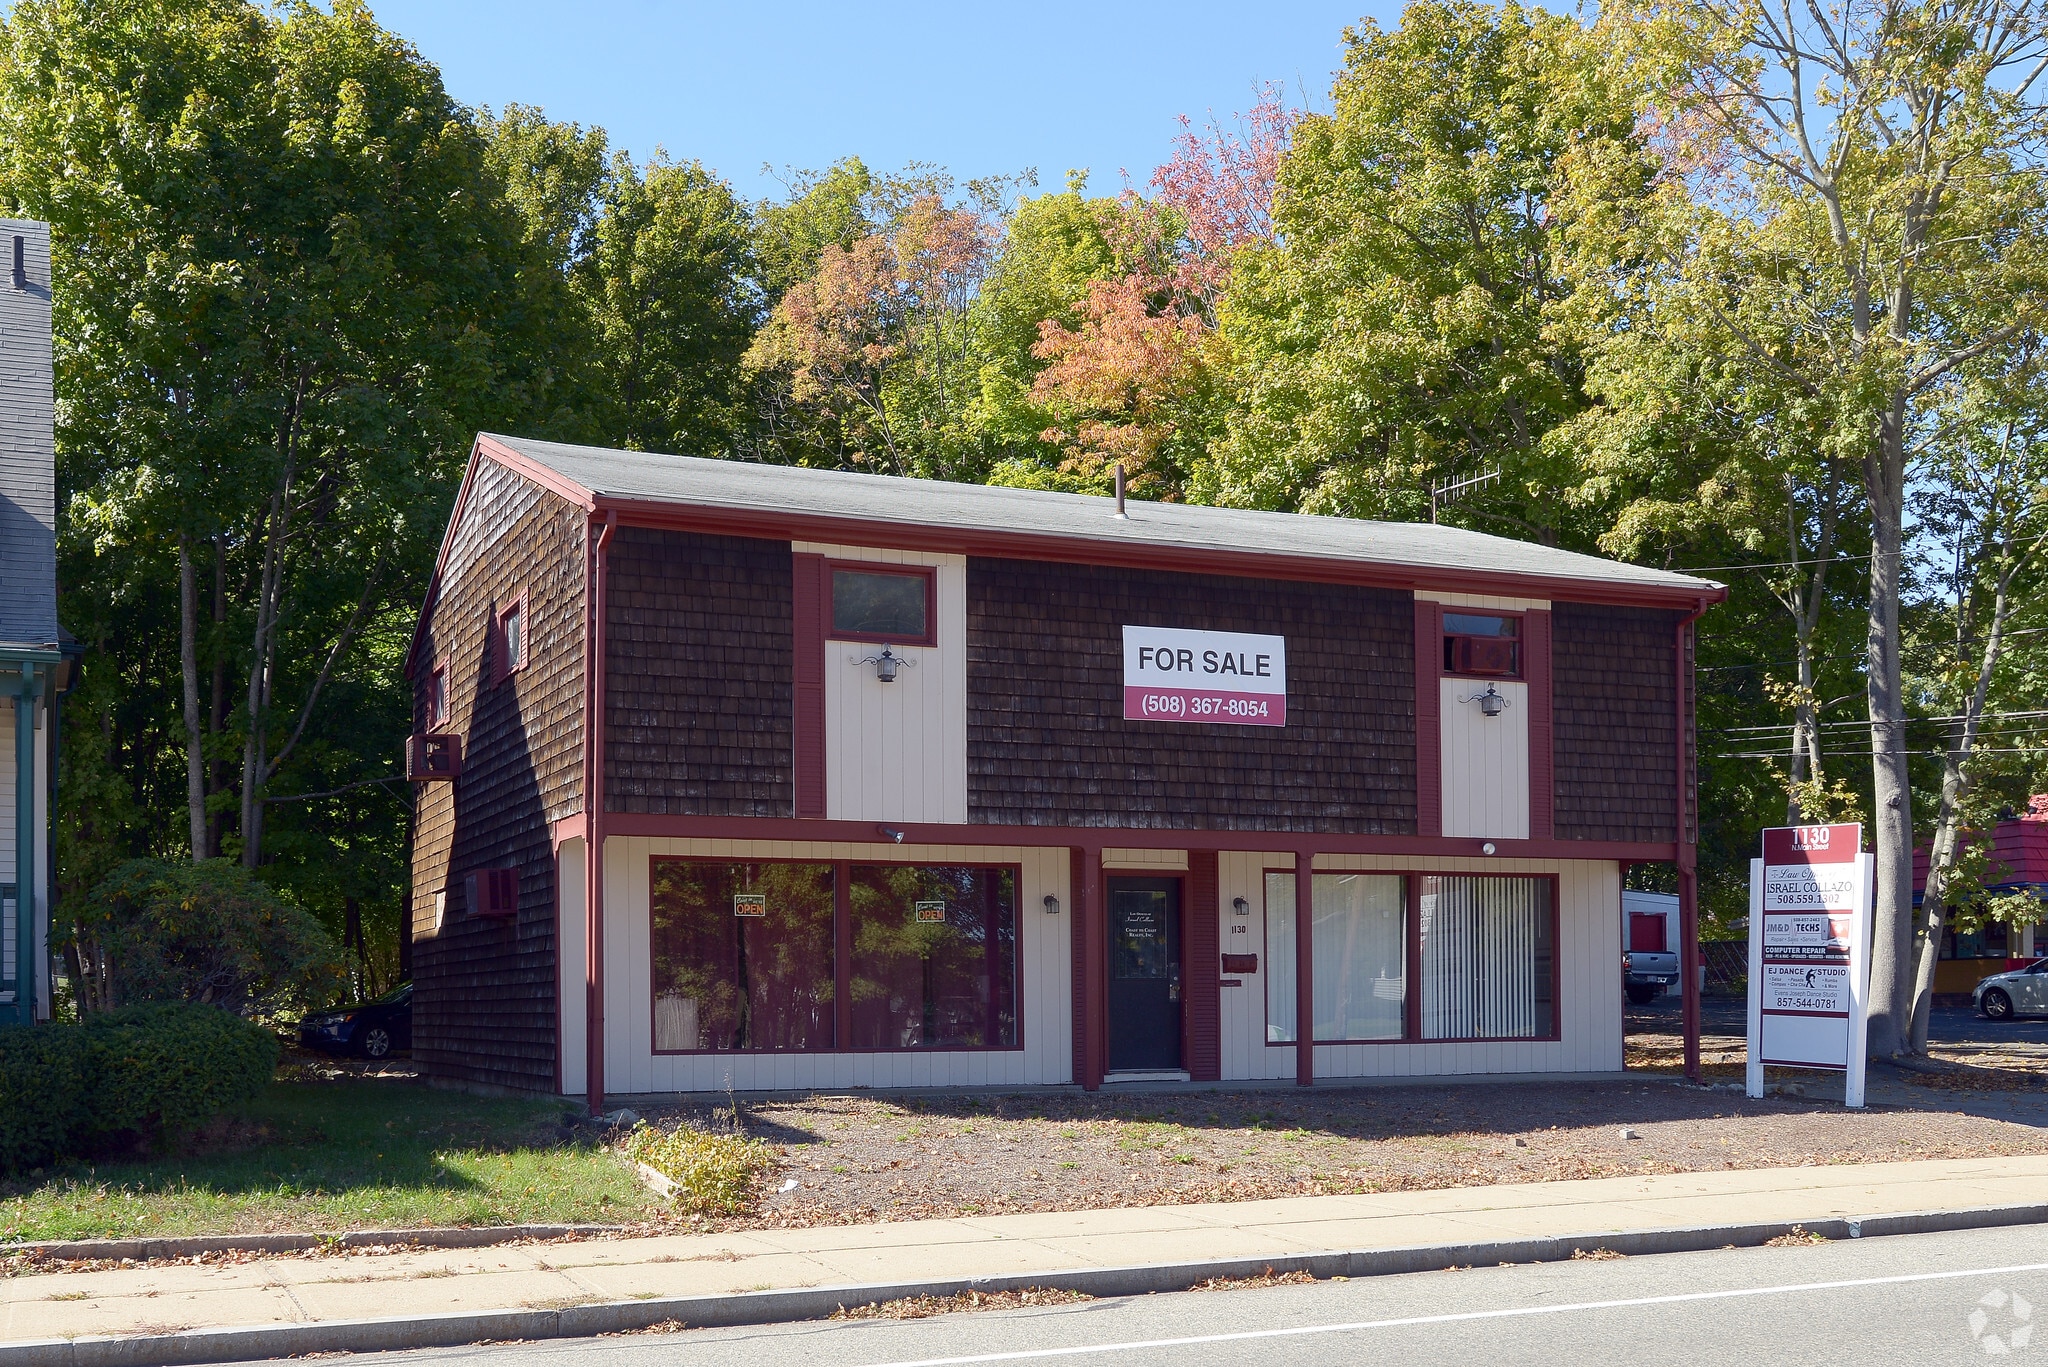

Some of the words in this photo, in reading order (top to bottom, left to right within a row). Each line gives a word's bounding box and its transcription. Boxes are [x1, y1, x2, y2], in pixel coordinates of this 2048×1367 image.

[1139, 646, 1194, 672] FOR
[1202, 650, 1271, 676] SALE
[1142, 694, 1186, 718] (508)
[1191, 697, 1268, 718] 367-8054
[1792, 827, 1830, 845] 1130
[1766, 882, 1801, 894] ISRAEL
[1803, 881, 1852, 893] COLLAZO
[1777, 894, 1840, 904] 508.559.1302
[736, 904, 763, 914] OPEN
[919, 910, 943, 920] OPEN
[1232, 925, 1246, 934] 1130
[1766, 924, 1790, 932] JM&D
[1796, 924, 1820, 932] TECHS
[1777, 997, 1836, 1008] 857-544-0781
